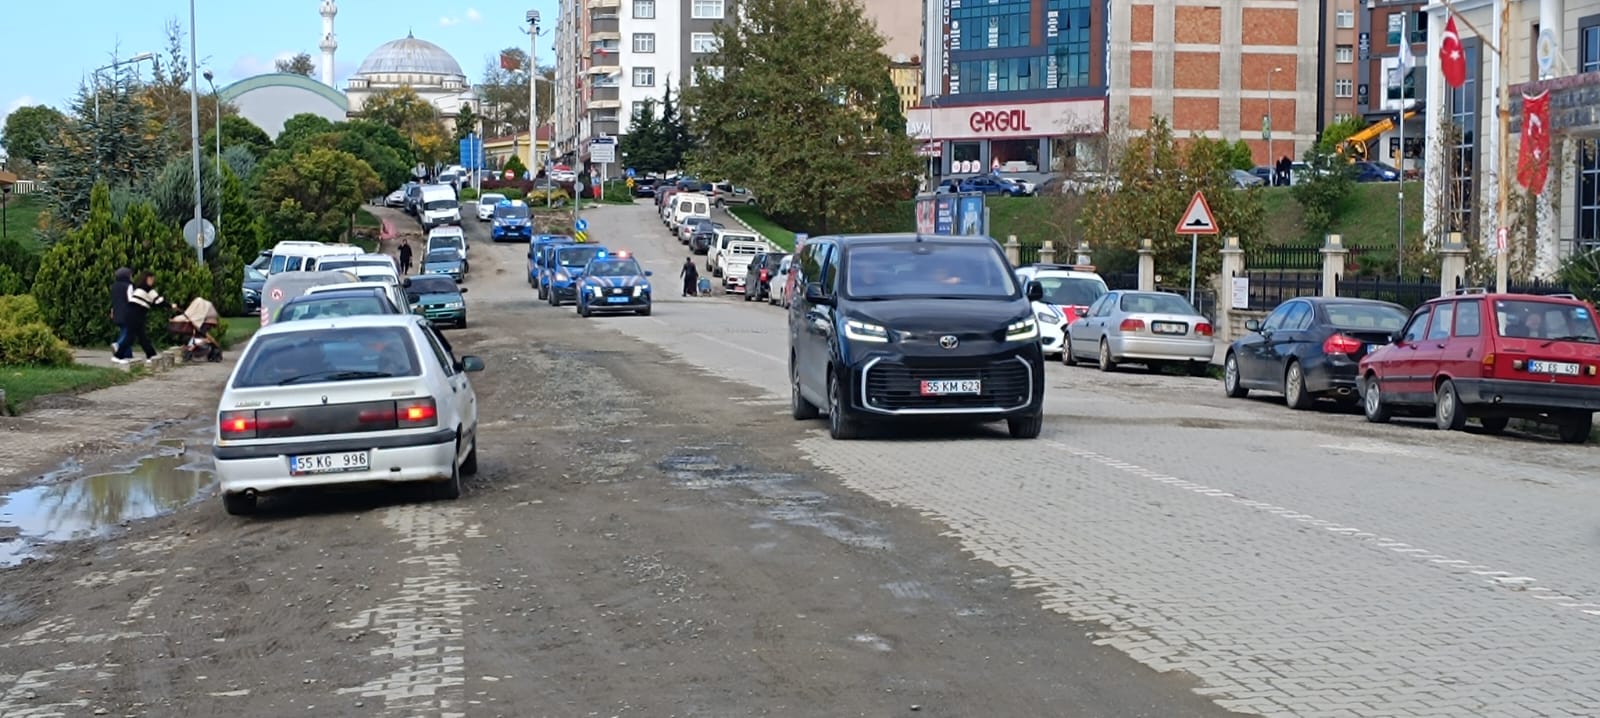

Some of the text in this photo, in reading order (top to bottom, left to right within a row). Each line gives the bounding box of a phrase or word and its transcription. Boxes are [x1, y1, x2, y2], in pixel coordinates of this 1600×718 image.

[927, 381, 980, 392] 55 KM 623
[297, 453, 366, 470] 55 KG 996
